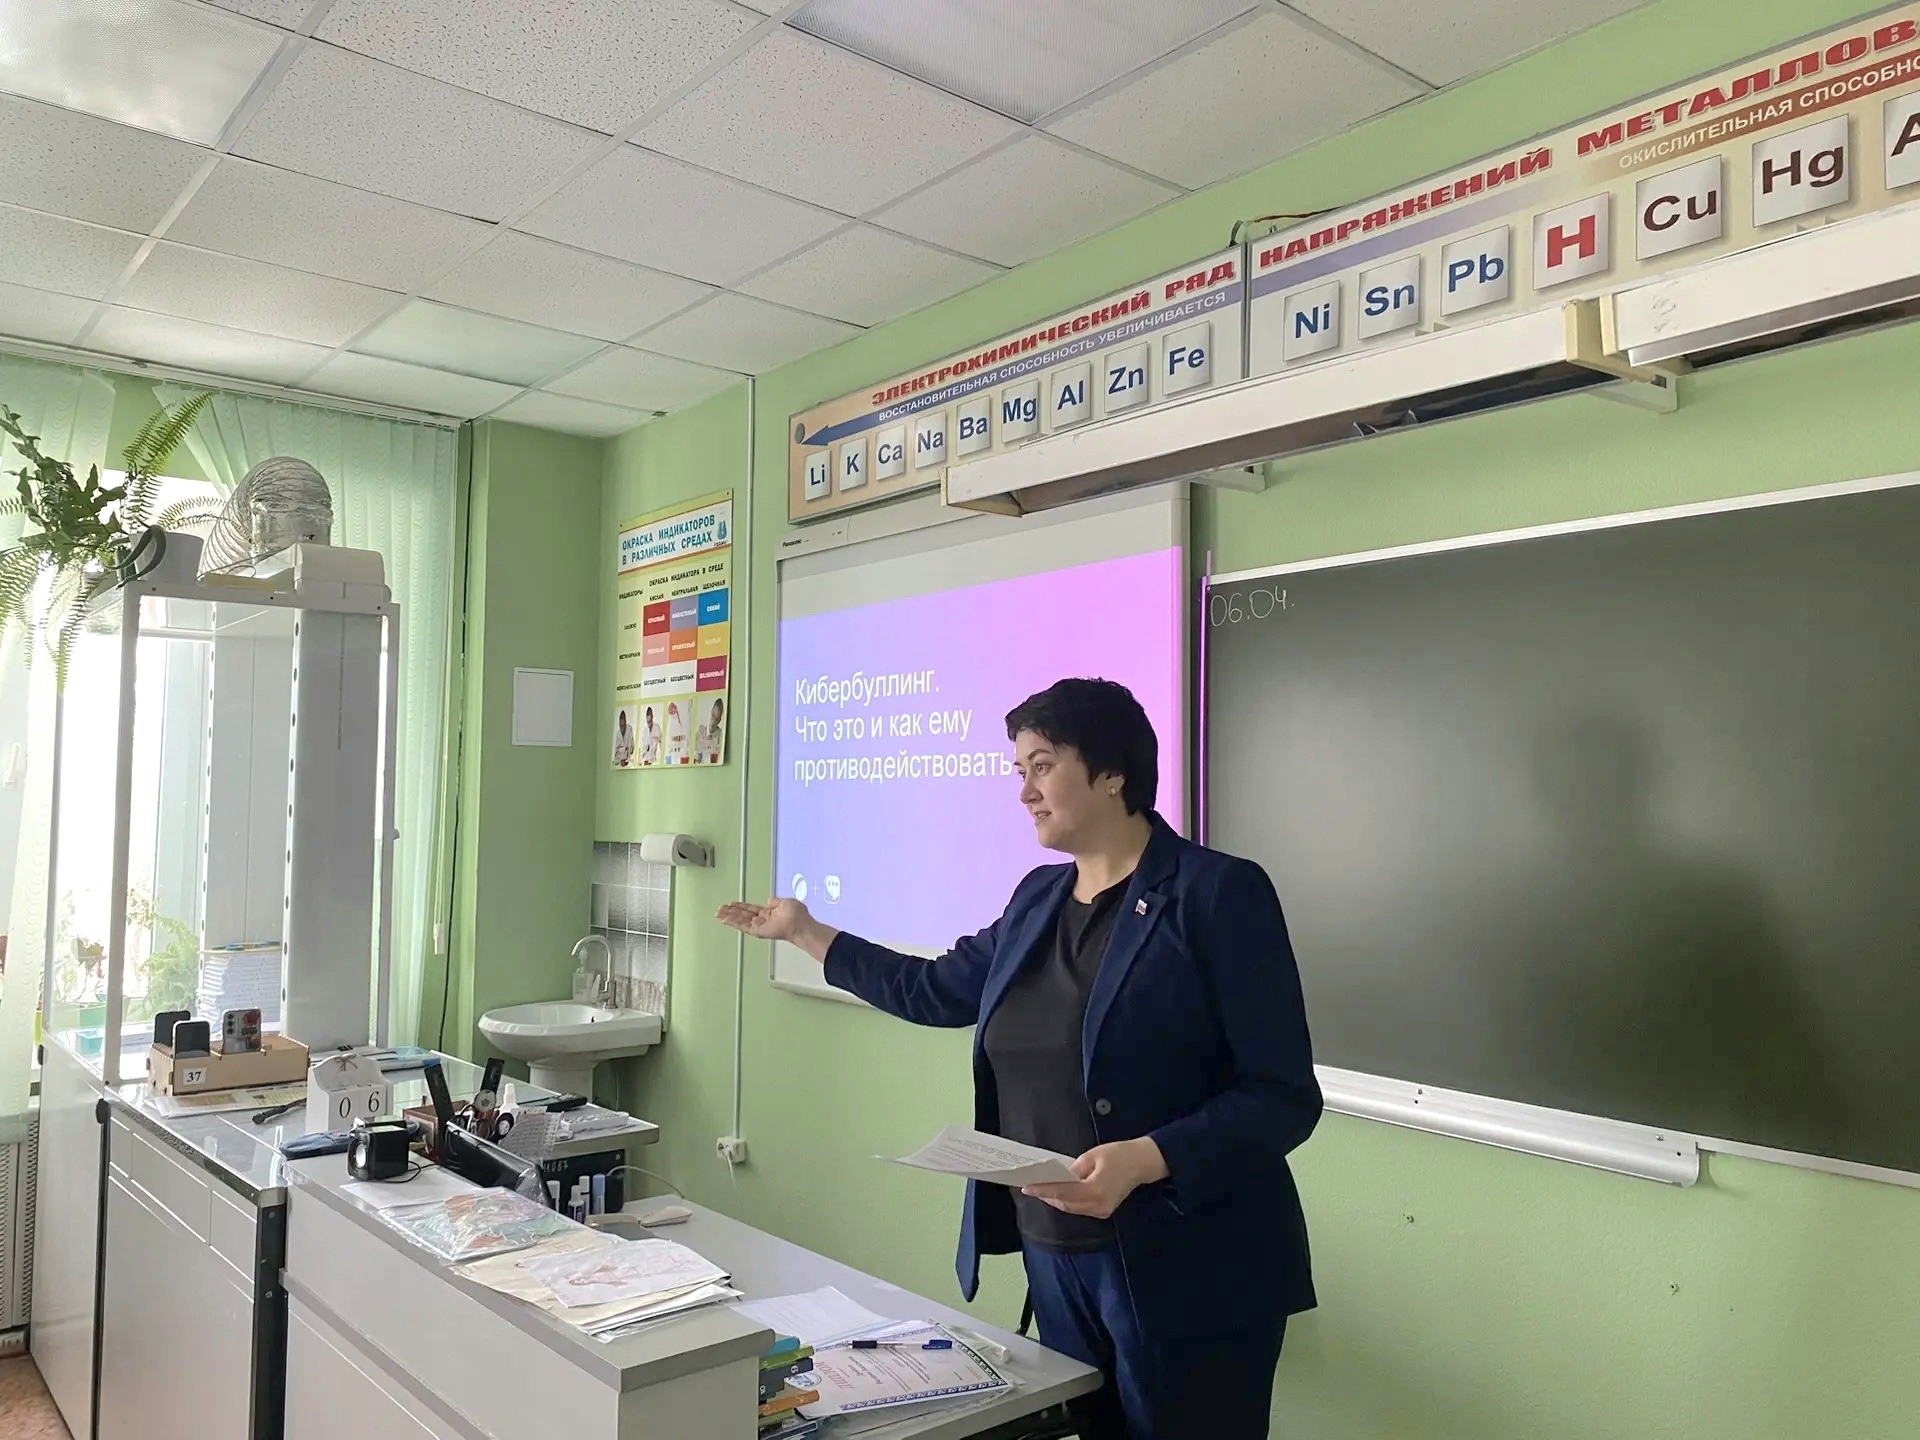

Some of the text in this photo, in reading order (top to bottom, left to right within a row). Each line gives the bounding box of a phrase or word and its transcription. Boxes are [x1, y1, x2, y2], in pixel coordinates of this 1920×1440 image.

[1619, 98, 1793, 169] ОКИСЛИТЕЛЬНАЯ
[872, 19, 1920, 406] ЭЛЕКТРОХИМИЧЕСКИЙ РЯД НАПРЯЖЕНИЙ МЕТАЛЛОВ
[1294, 303, 1331, 339] Ni
[1364, 281, 1415, 317] Sn
[1448, 253, 1504, 292] Pb
[1547, 215, 1596, 268] H
[1644, 186, 1717, 232] Cu
[1762, 141, 1844, 195] Hg
[878, 291, 1226, 421] ВОССТАНОВИТЕЛЬНАЯ СПОСОБНОСТЬ УВЕЛИЧИВАЕТСЯ
[810, 347, 1206, 486] Li K Ca Na Ba Mg Al Zn Fe
[622, 514, 716, 551] ОКРАСКА ИНДИКАТОРОВ
[622, 531, 713, 565] В РАЗЛИЧНЫХ СРЕДАХ
[649, 576, 669, 587] ОКРАСКА
[708, 562, 724, 573] СРЕДЕ
[1210, 585, 1295, 627] 06.04.
[795, 669, 940, 709] Кибербуллинг.
[795, 708, 972, 743] Что это и как ему
[794, 750, 1012, 788] противодействовать
[186, 1071, 202, 1084] 37
[339, 1090, 380, 1119] 0 6
